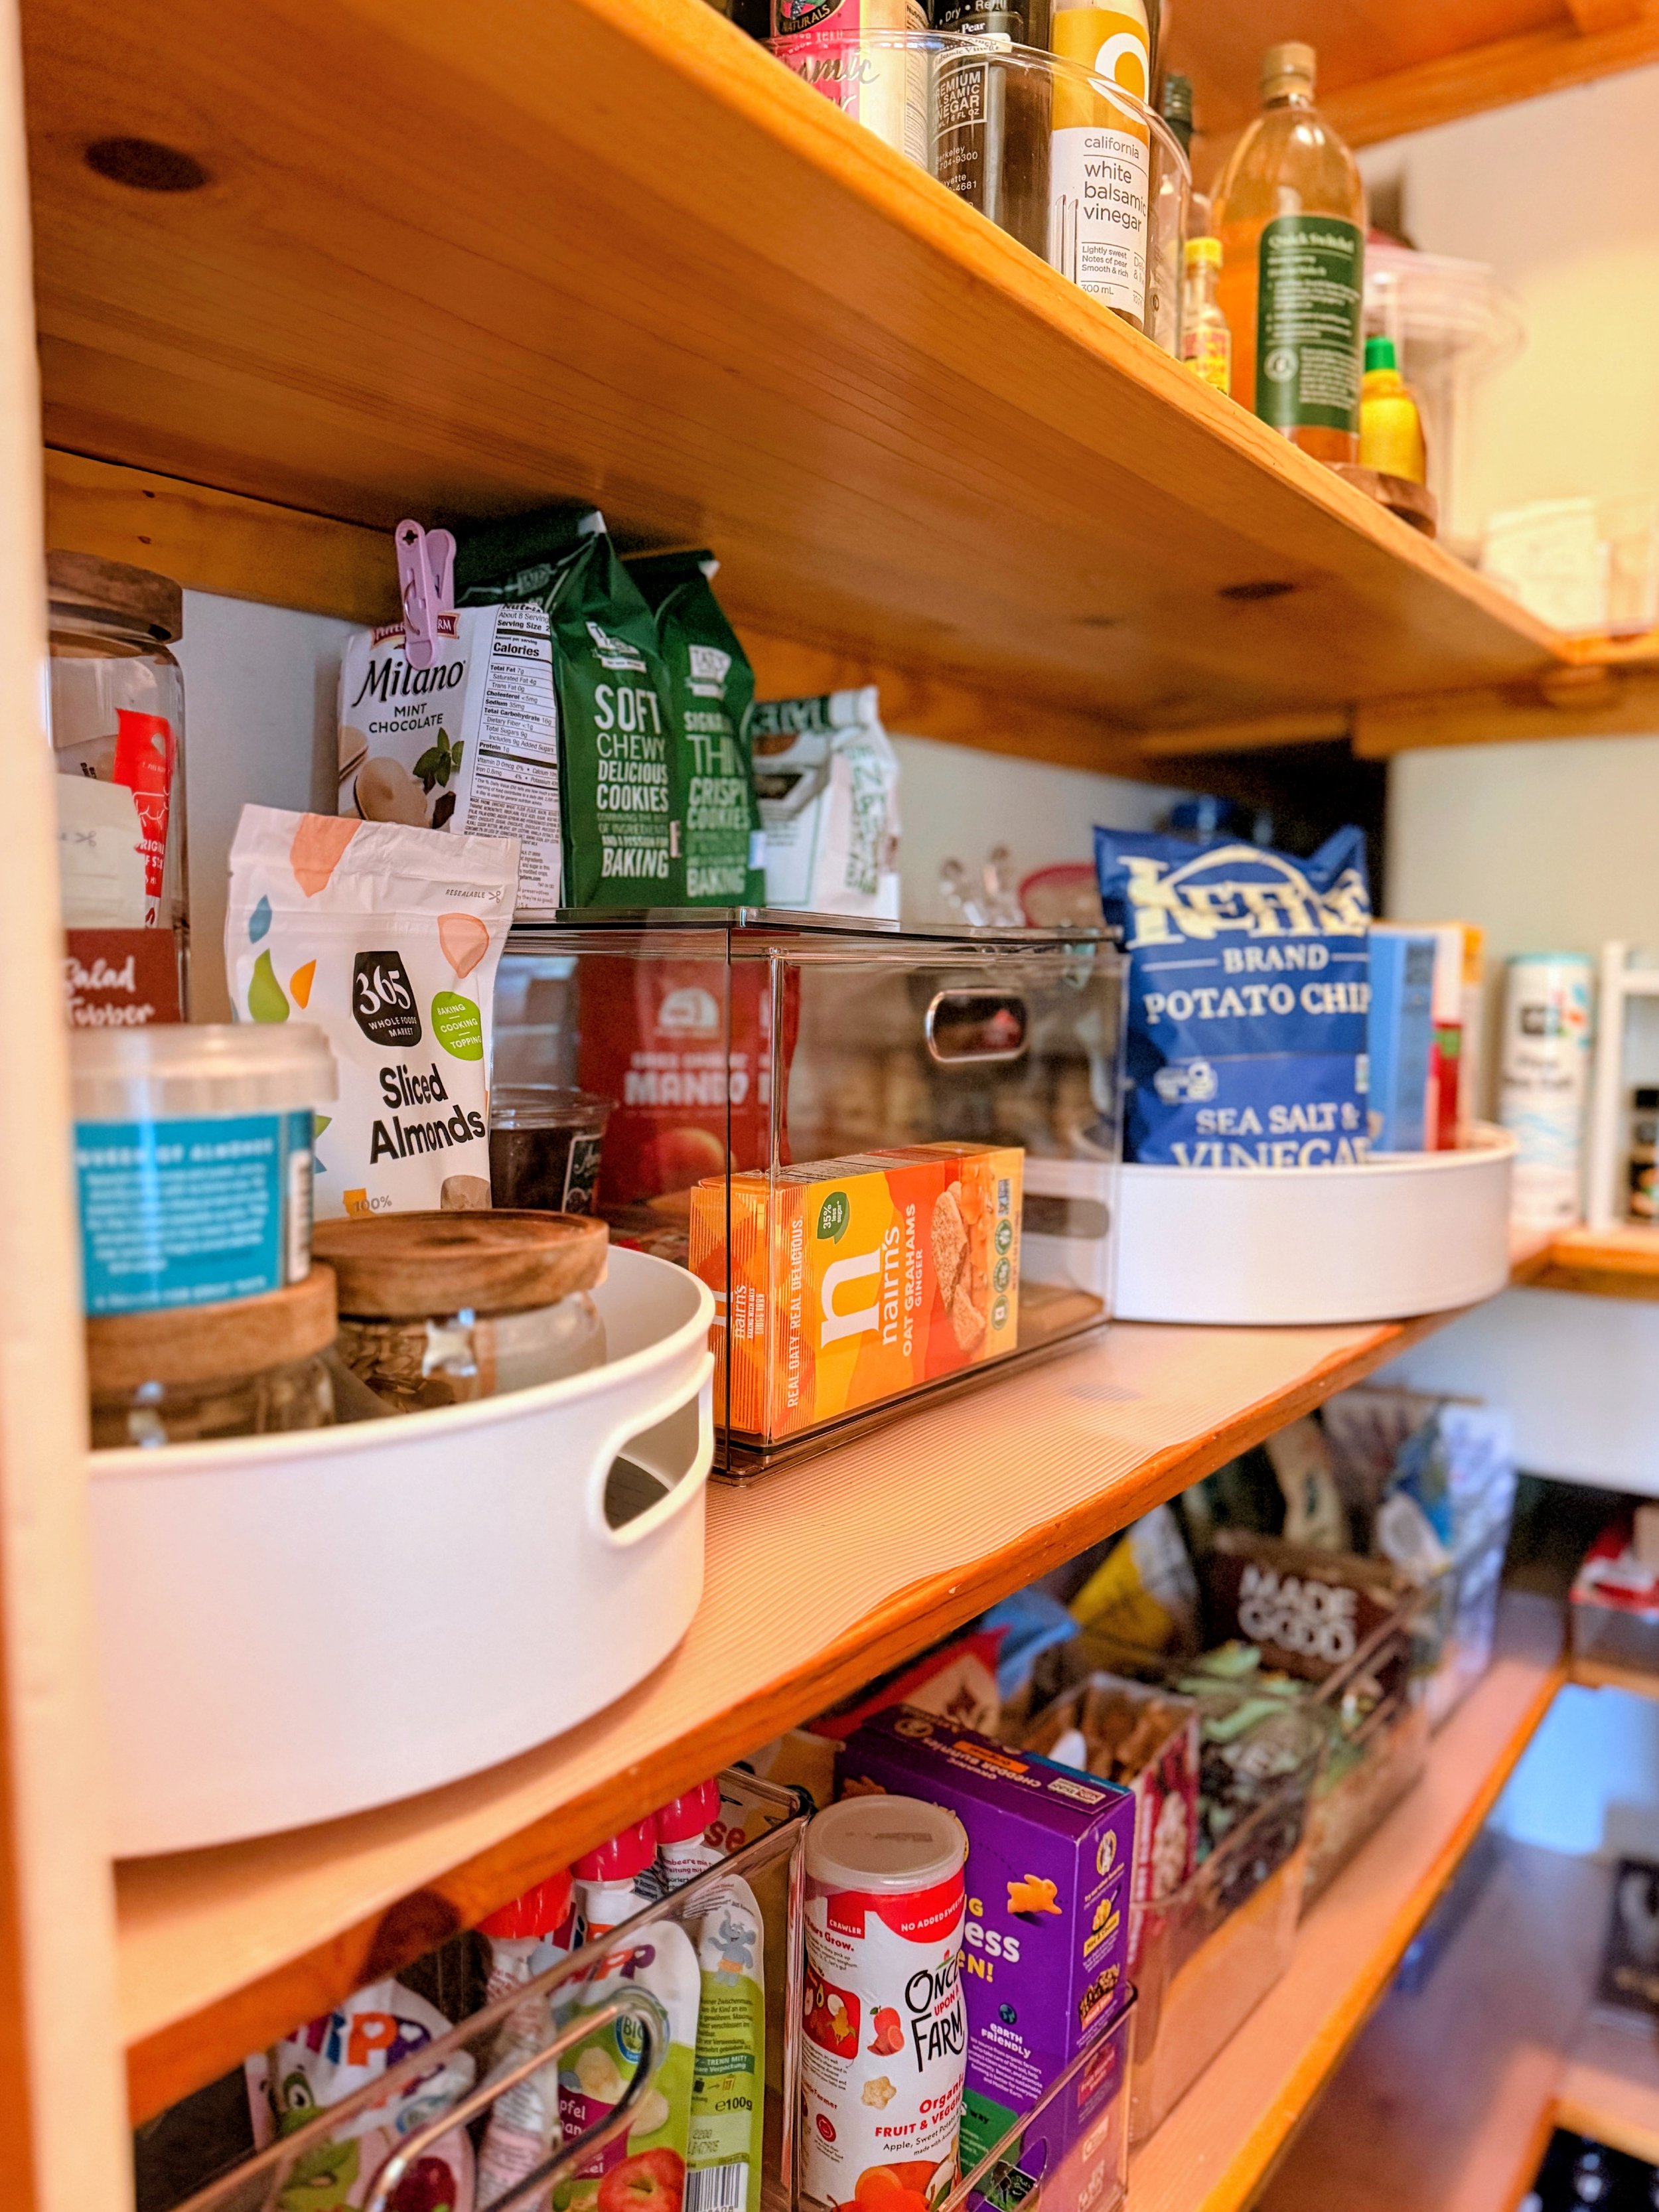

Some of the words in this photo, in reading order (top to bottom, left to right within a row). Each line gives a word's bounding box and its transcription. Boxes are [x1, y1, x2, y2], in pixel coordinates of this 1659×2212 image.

[781, 4, 830, 33] NATURALS
[945, 7, 961, 22] Dry
[962, 23, 985, 33] Pear
[1084, 136, 1139, 159] california
[1084, 161, 1131, 184] white
[1084, 181, 1147, 217] balsamic
[1083, 203, 1142, 232] vinegar
[1082, 246, 1108, 256] Lightly
[1108, 249, 1127, 259] sweet
[1082, 255, 1104, 263] Notes
[1082, 264, 1110, 273] Smooth
[1118, 269, 1129, 278] rich
[497, 620, 524, 629] Serving
[526, 622, 542, 631] Size
[493, 642, 540, 657] Calories
[352, 658, 463, 707] Milano
[492, 674, 519, 682] Saturated
[486, 690, 520, 700] Cholesterol
[508, 701, 525, 711] 35mg
[394, 703, 427, 717] MINT
[500, 709, 540, 722] Carbohydrate
[594, 684, 661, 734] SOFT
[369, 713, 443, 733] CHOCOLATE
[500, 727, 519, 737] Sugars
[489, 735, 512, 744] Includes
[521, 740, 538, 749] Added
[538, 744, 554, 753] Sugars
[597, 733, 666, 761] CHEWY
[598, 760, 668, 785] DELICIOUS
[597, 784, 669, 812] COOKIES
[601, 848, 669, 878] BAKING
[687, 865, 746, 897] BAKING
[445, 888, 486, 900] RESEALABLE
[1222, 944, 1329, 974] BRAND
[356, 965, 411, 1014] 365
[437, 1003, 466, 1015] BAKING
[1143, 983, 1297, 1025] POTATO
[368, 1017, 400, 1030] WHOLE
[400, 1016, 417, 1025] FOODS
[389, 1027, 413, 1037] MARKET
[440, 1018, 478, 1033] COOKING
[450, 1035, 482, 1049] TOPPING
[379, 1063, 449, 1109] Sliced
[1196, 1107, 1262, 1136] SEA
[1268, 1103, 1338, 1134] SALT
[1341, 1102, 1359, 1131] &
[370, 1104, 486, 1165] Almonds
[353, 1195, 392, 1213] 100%
[823, 1204, 831, 1229] 35%
[791, 1216, 804, 1291] DELICIOUS.
[904, 1203, 916, 1311] GRAHAMS
[882, 1226, 901, 1345] nairn's
[821, 1247, 881, 1349] n
[734, 1285, 747, 1339] nairn's
[790, 1293, 801, 1329] REAL
[902, 1316, 913, 1357] OAT
[789, 1333, 800, 1370] OATY.
[788, 1374, 799, 1408] REAL
[829, 1919, 861, 1935] CRAWLER
[901, 1923, 915, 1931] NO
[917, 1912, 944, 1929] ADDED
[825, 1932, 854, 1951] Grow.
[934, 1991, 955, 2017] UPON
[911, 2000, 965, 2073] FARM
[875, 2123, 916, 2137] FRUIT
[920, 2120, 928, 2130] &
[883, 2141, 913, 2152] Apple,
[916, 2130, 938, 2145] Sweet
[914, 2146, 930, 2156] made
[930, 2139, 941, 2148] with
